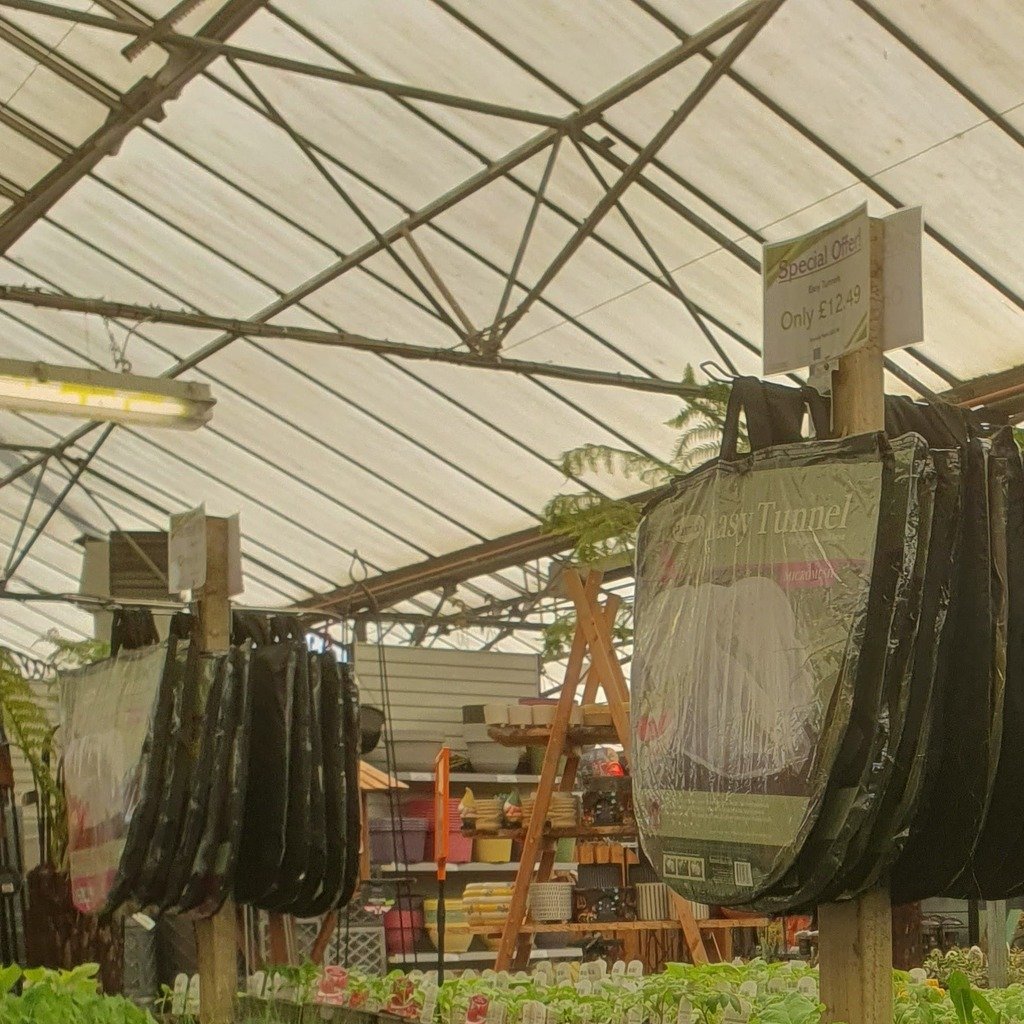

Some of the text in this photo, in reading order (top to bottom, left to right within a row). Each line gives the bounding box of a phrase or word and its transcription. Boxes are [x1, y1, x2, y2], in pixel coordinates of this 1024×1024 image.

[778, 244, 828, 281] Special
[781, 284, 861, 330] Only £12.49
[756, 497, 850, 536] Tunnel
